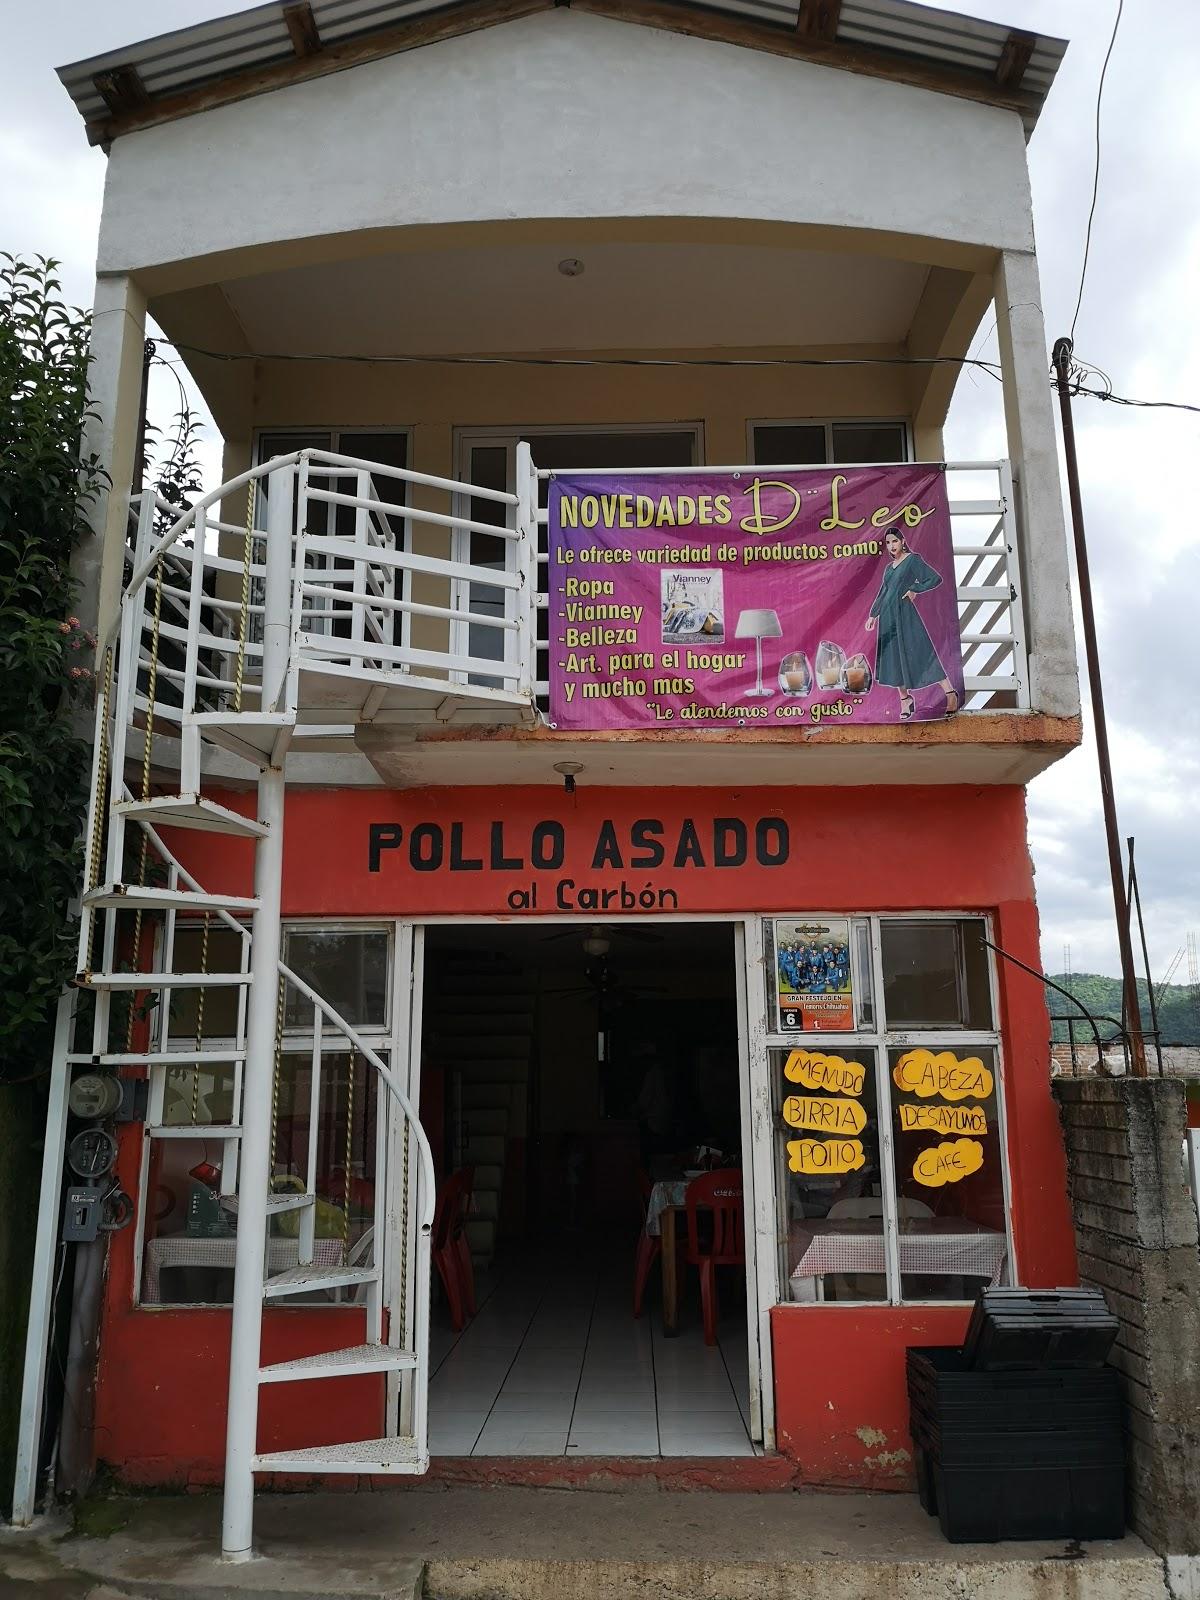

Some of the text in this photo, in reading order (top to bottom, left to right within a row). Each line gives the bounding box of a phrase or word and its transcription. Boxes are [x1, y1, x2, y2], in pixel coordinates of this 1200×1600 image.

[560, 494, 732, 529] NOVEDADES
[819, 475, 936, 530] Leo
[557, 539, 883, 566] Le ofrece variedad de productos como:
[558, 577, 615, 600] -Ropa
[672, 574, 712, 585] Vianney
[558, 602, 644, 625] -Vianney
[558, 625, 638, 648] -Belleza
[558, 650, 746, 676] -Art. para el hogar
[564, 676, 695, 702] y mucho mas
[679, 702, 769, 720] atendemos
[775, 704, 805, 719] con
[368, 816, 791, 873] POLLO ASADO
[507, 878, 679, 911] al Carbón
[786, 1013, 796, 1025] 6
[791, 1057, 864, 1094] MENUDO
[901, 1059, 984, 1092] CABEZA
[789, 1098, 858, 1130] BIRRIA
[905, 1106, 988, 1131] DESAYUNOS
[918, 1151, 966, 1177] CAFE
